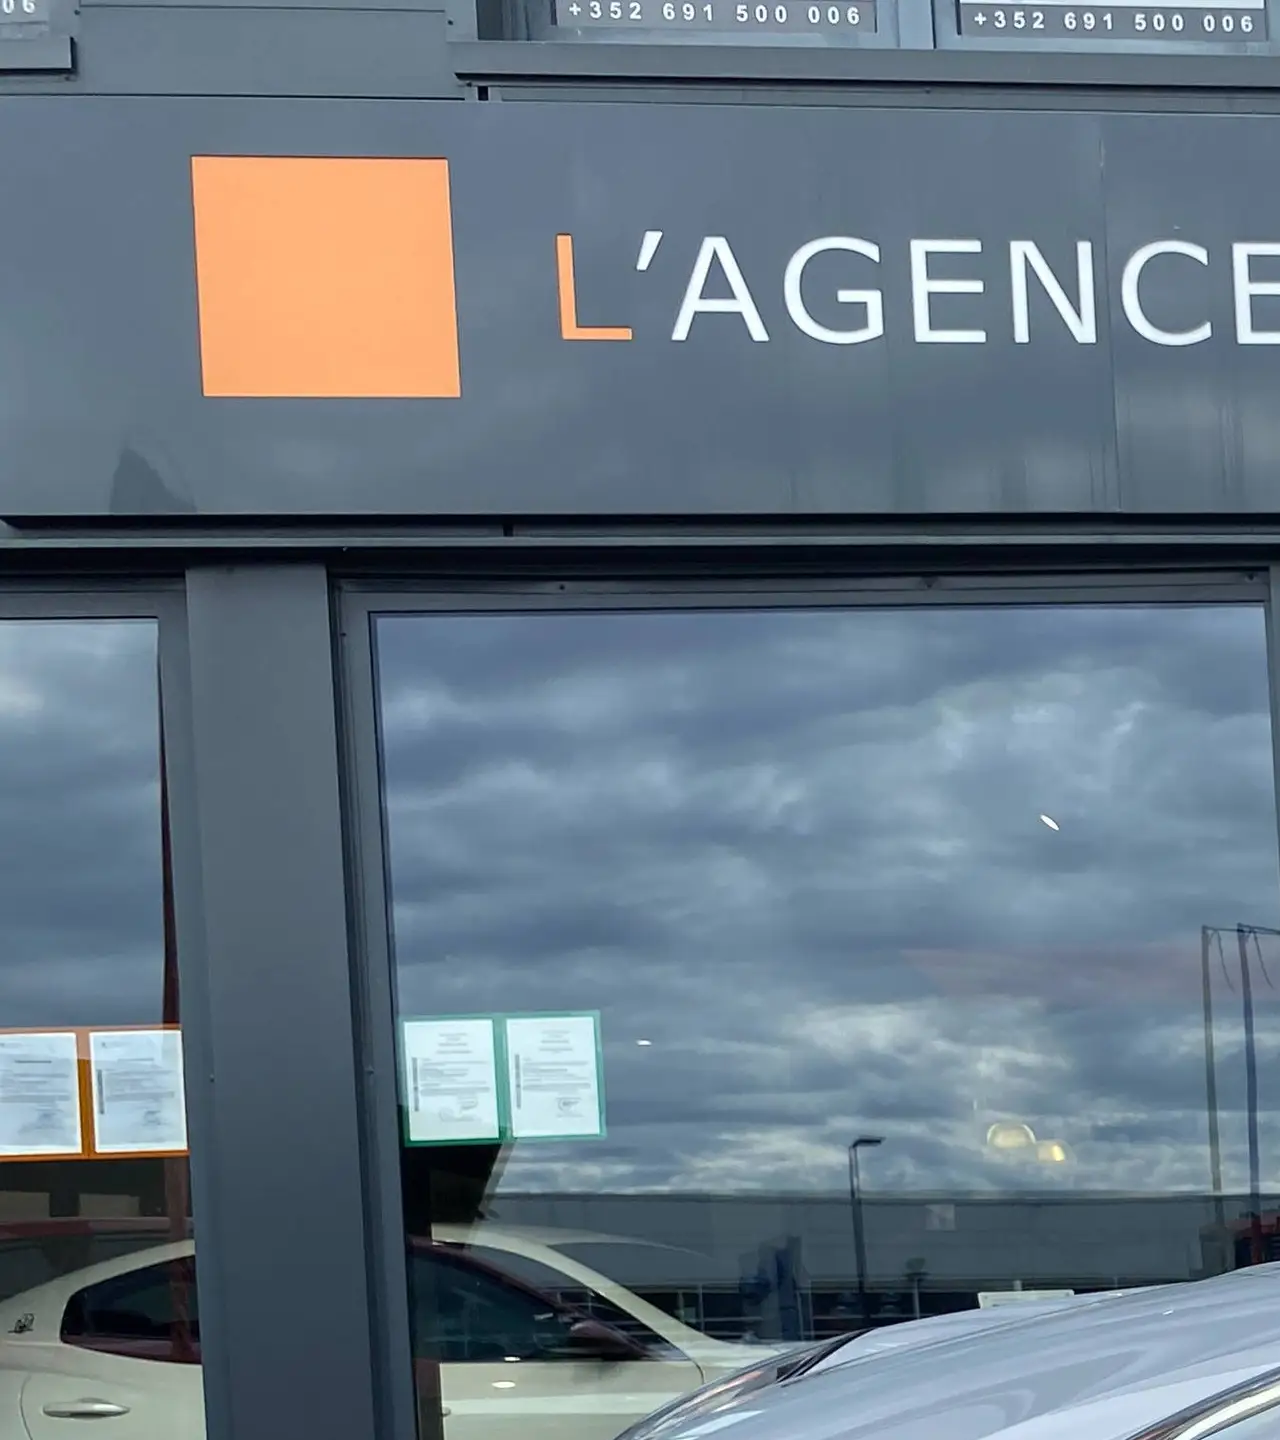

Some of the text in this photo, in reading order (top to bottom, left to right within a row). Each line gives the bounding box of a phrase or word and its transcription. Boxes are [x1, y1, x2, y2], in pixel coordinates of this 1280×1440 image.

[569, 1, 860, 25] +352 691 500 006
[974, 10, 1254, 33] +352 691 500 006
